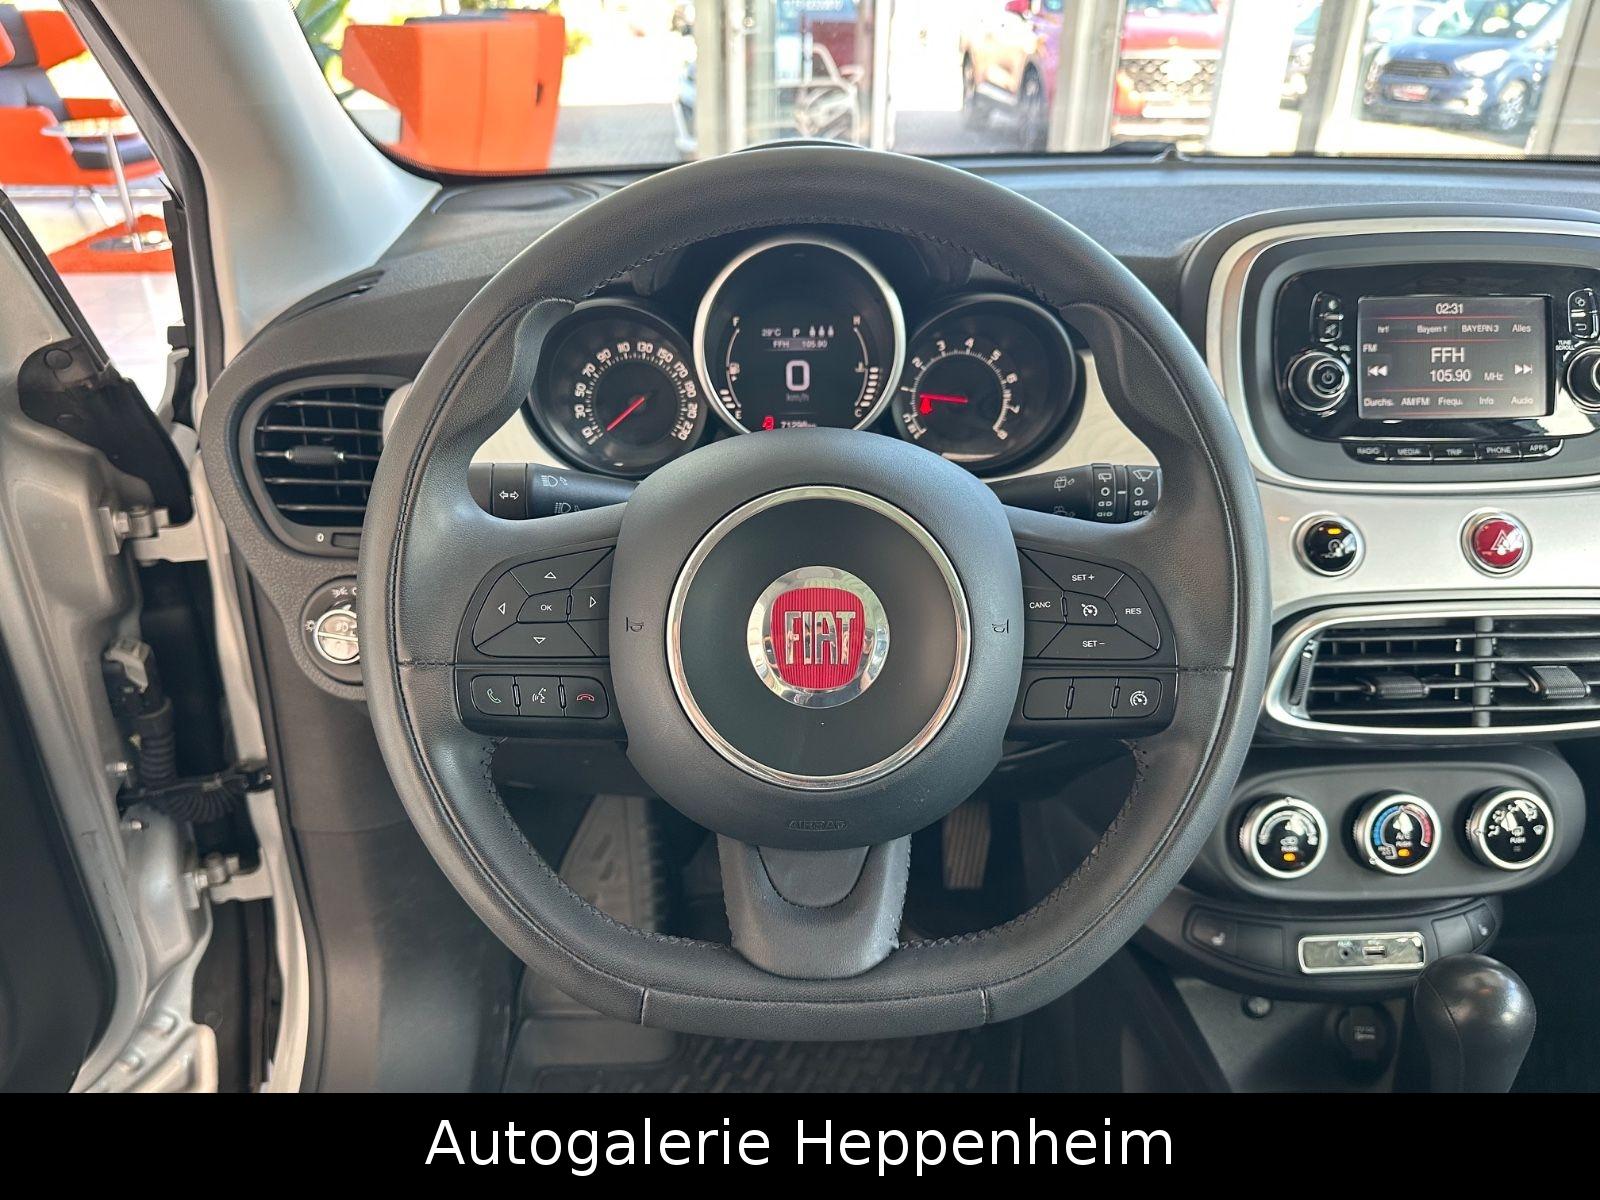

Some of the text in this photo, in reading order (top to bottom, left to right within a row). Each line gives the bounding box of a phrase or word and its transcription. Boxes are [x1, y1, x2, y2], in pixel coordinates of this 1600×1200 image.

[1435, 303, 1463, 314] 02:31
[1416, 324, 1441, 334] Bayern
[1461, 324, 1493, 333] BAYERN
[1511, 324, 1532, 333] Alles
[636, 341, 654, 354] 130
[772, 339, 790, 348] FFH
[1363, 344, 1378, 353] FM
[596, 348, 612, 364] 90
[657, 347, 674, 363] 150
[1431, 347, 1465, 363] FFH
[582, 362, 597, 378] 70
[673, 361, 689, 379] 170
[786, 359, 811, 391] 0
[1430, 368, 1504, 382] 105.90 MHz
[574, 382, 587, 398] 50
[1479, 396, 1494, 405] Info
[1511, 395, 1534, 405] Audio
[574, 403, 586, 420] 30
[1356, 446, 1380, 455] RADIO
[1486, 445, 1511, 454] PHONE
[1529, 443, 1549, 452] APPS
[540, 603, 552, 612] OK
[1029, 601, 1051, 609] CANC
[1125, 607, 1142, 615] RES
[784, 611, 856, 665] FIAT
